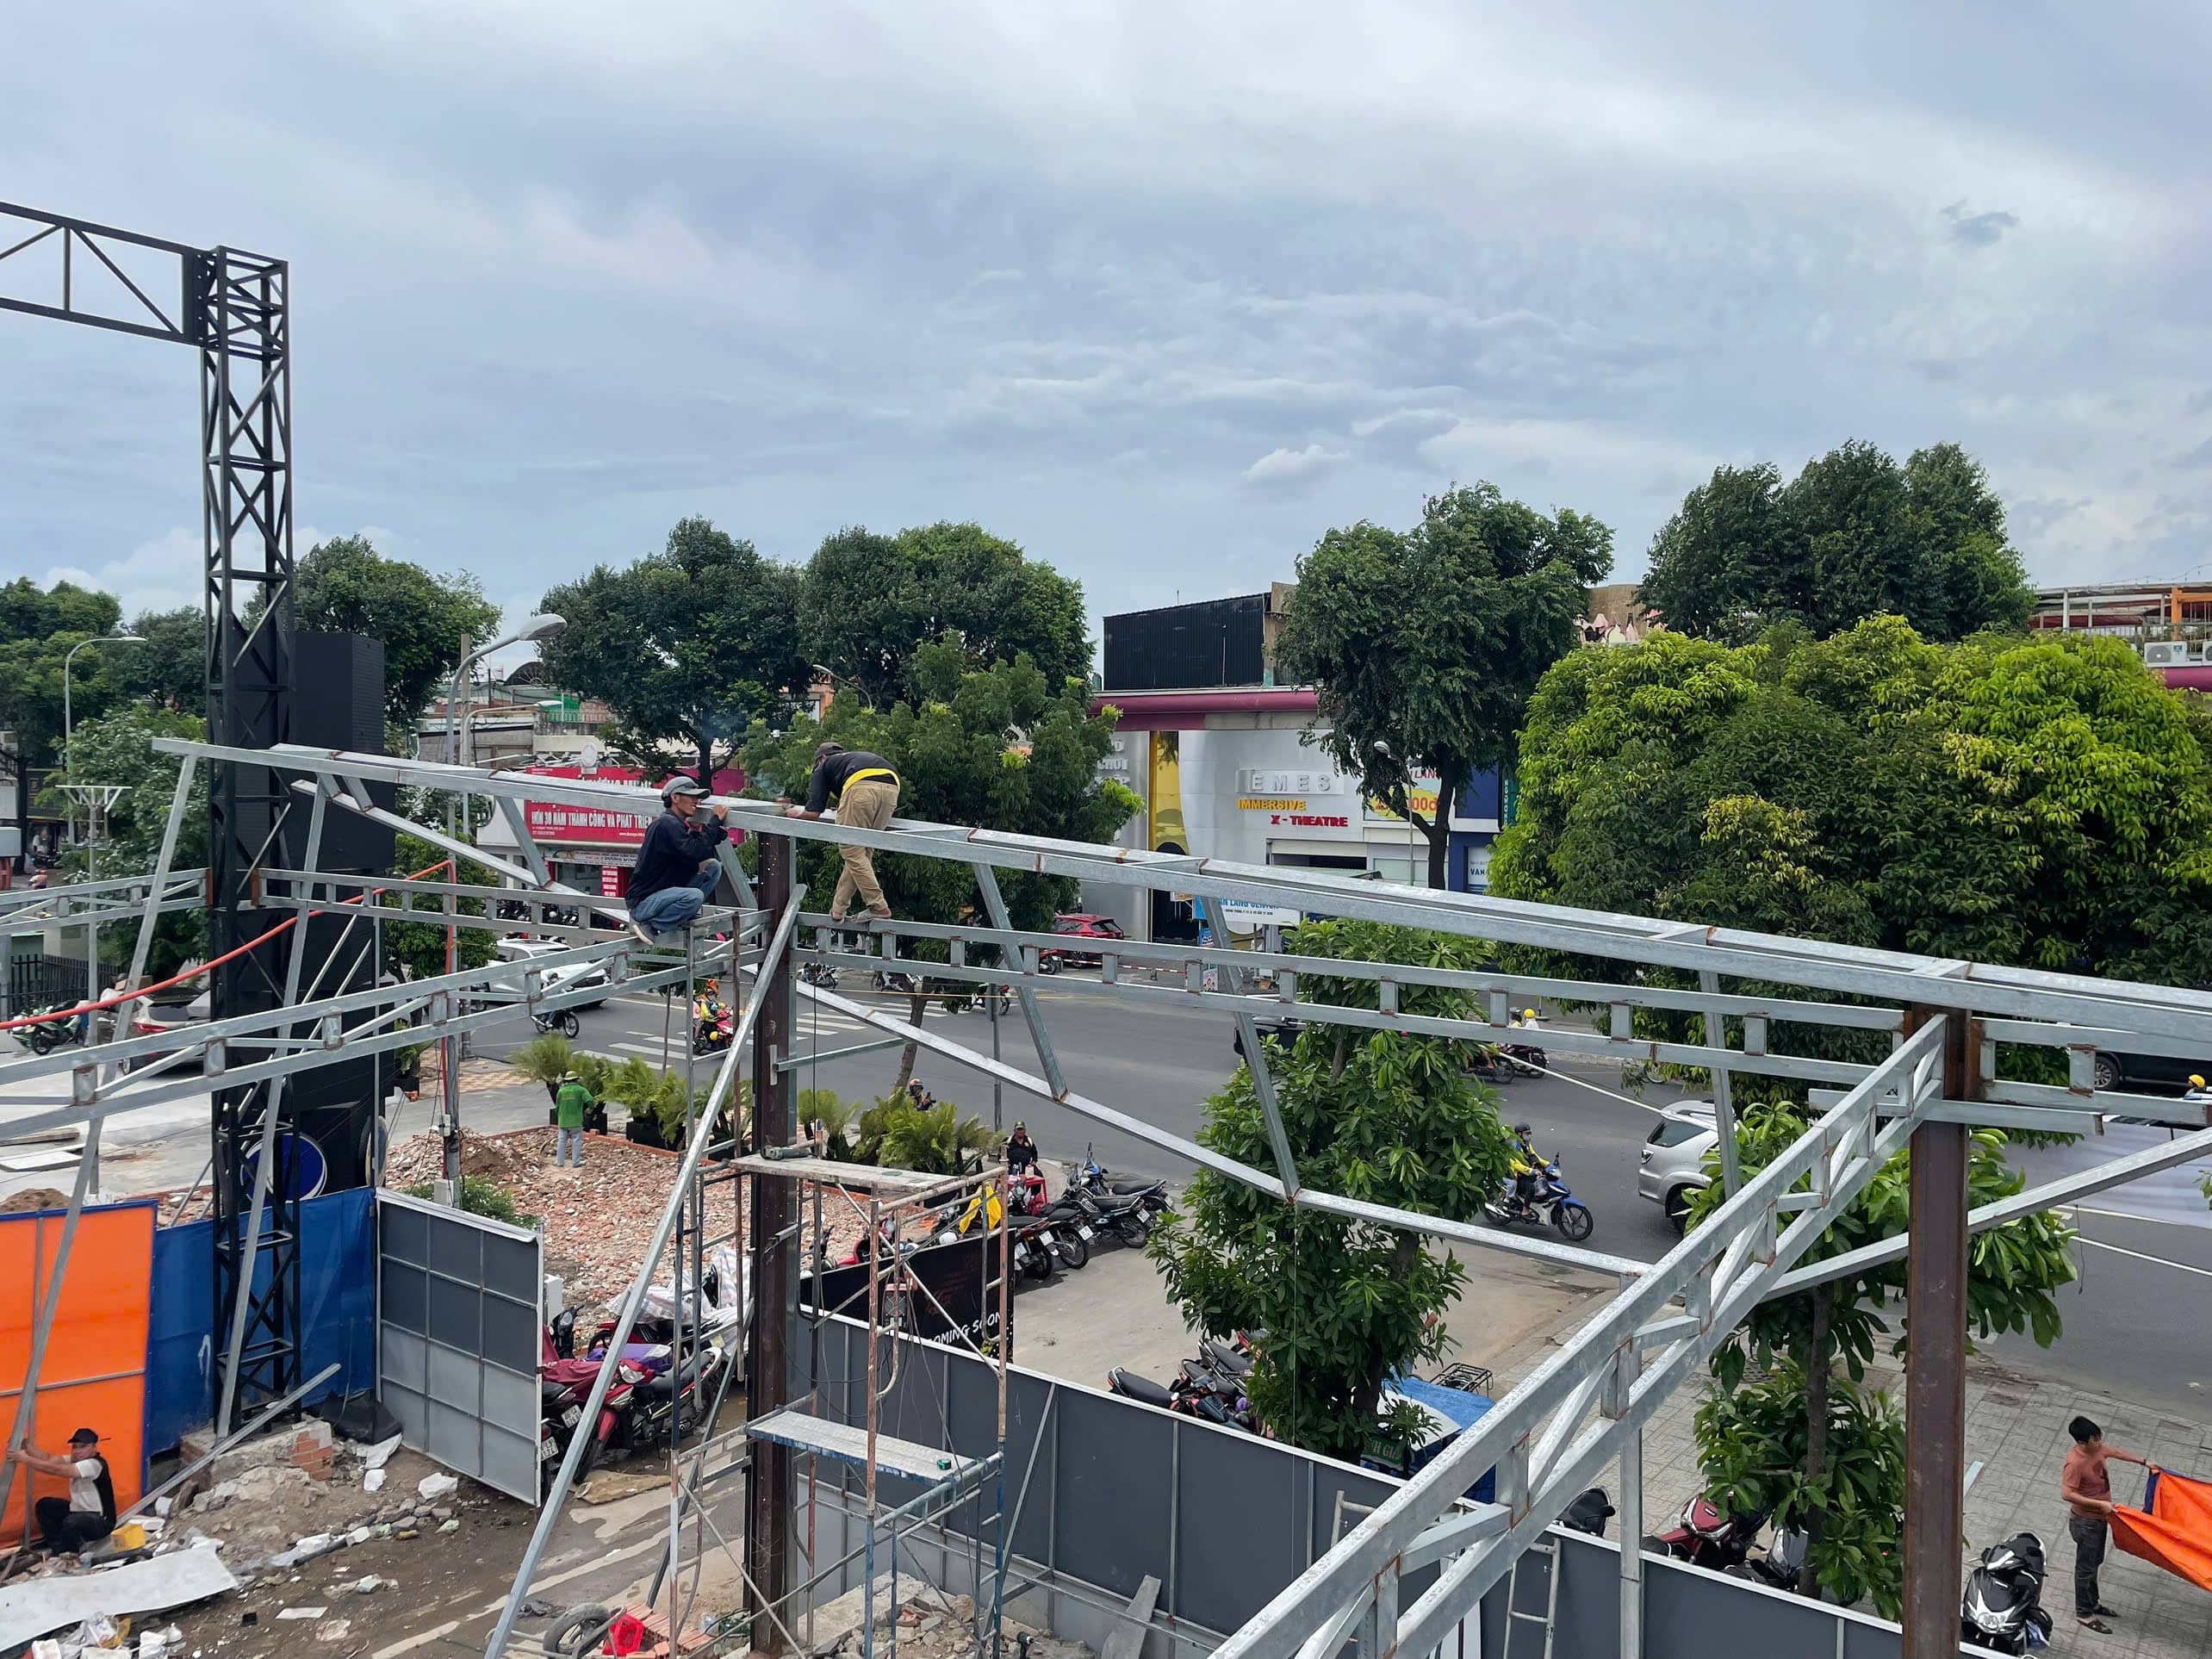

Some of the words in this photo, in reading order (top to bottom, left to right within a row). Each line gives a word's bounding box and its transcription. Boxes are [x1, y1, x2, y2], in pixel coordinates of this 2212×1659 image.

[1238, 798, 1307, 811] IMMERSIVE
[544, 811, 552, 825] 30
[1289, 815, 1348, 827] THEATRE
[926, 1324, 971, 1345] OMING
